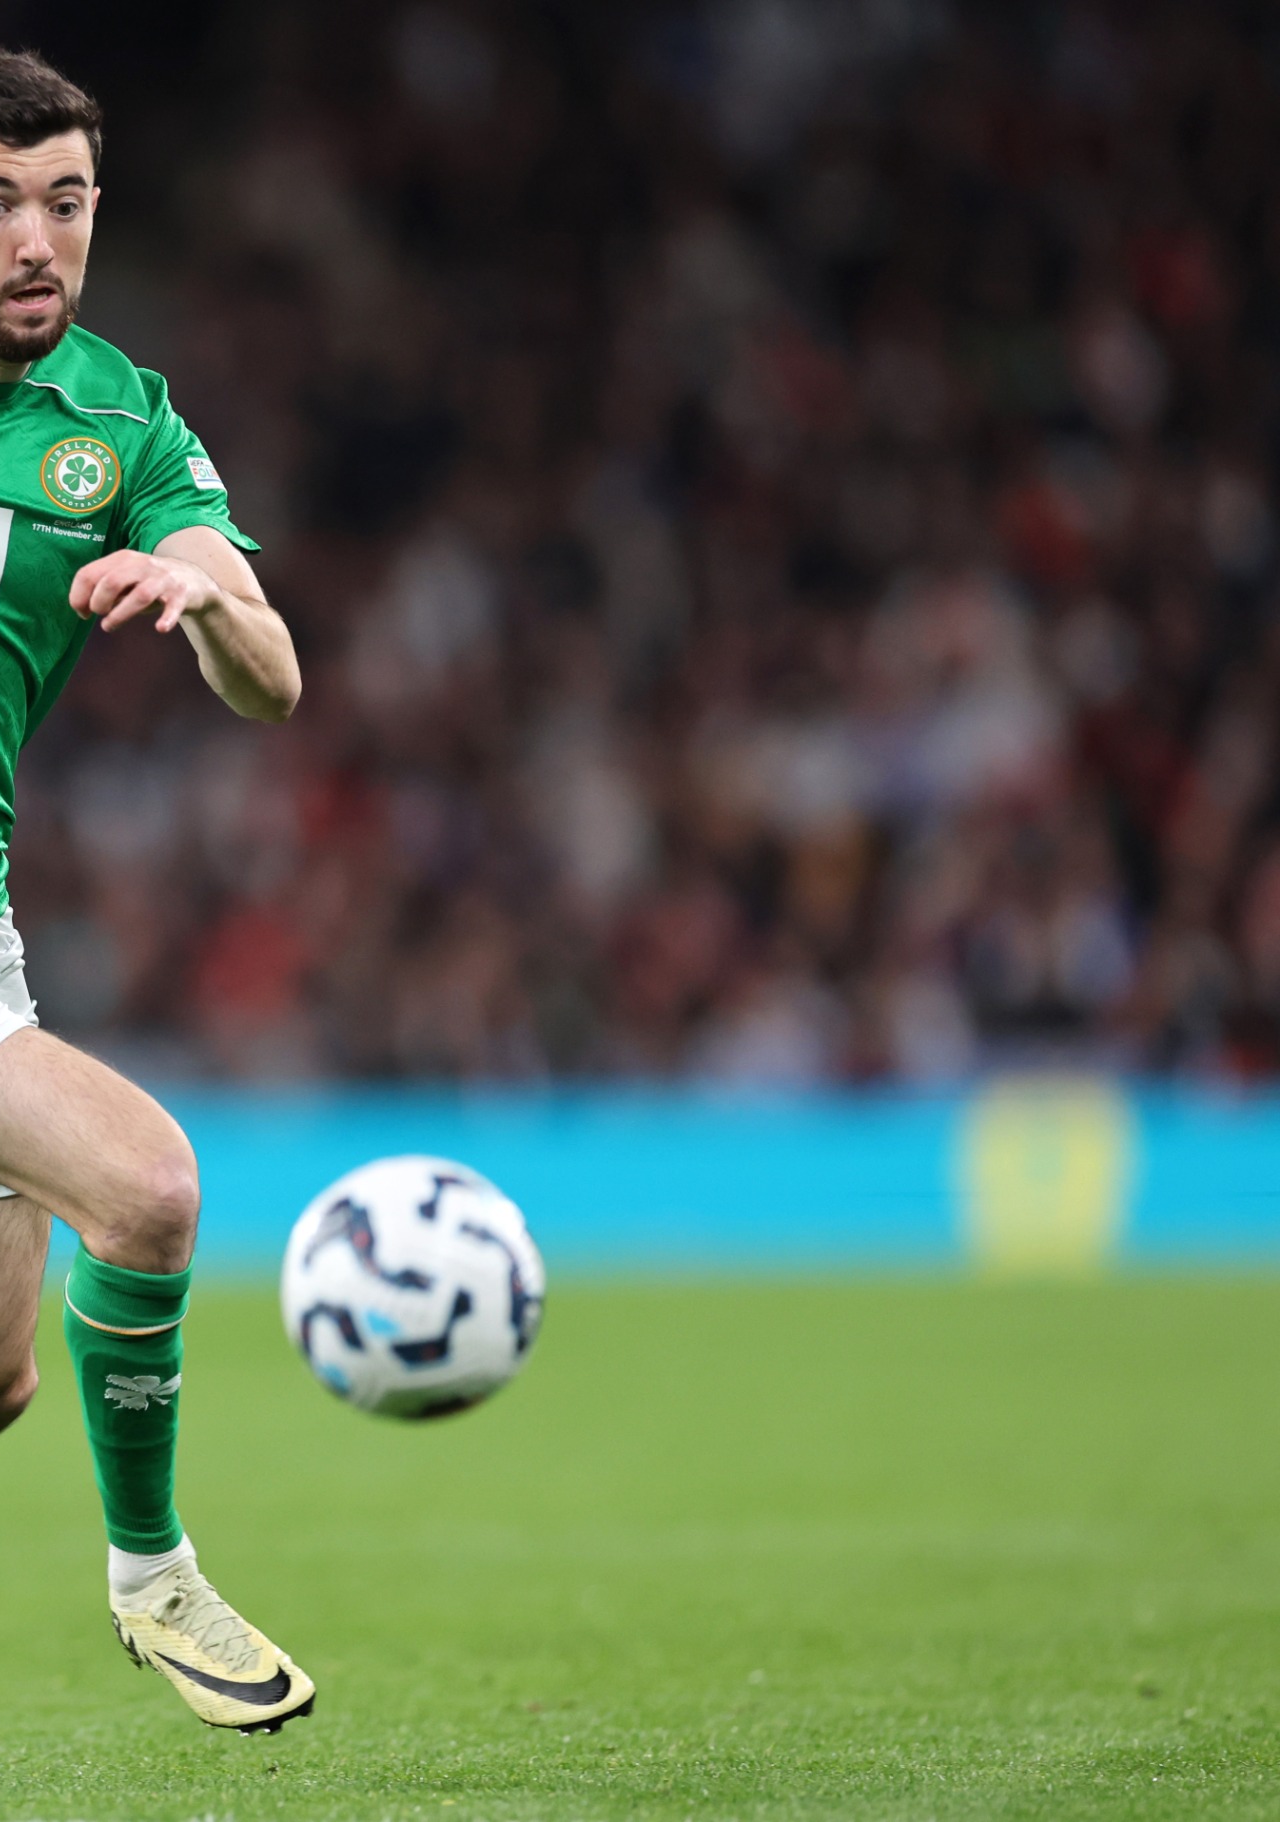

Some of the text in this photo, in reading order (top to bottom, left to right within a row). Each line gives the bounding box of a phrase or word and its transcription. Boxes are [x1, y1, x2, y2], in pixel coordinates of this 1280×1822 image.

[48, 441, 111, 465] IRELAND
[56, 493, 103, 508] FOOTBALL
[31, 522, 106, 542] 17TH November 202
